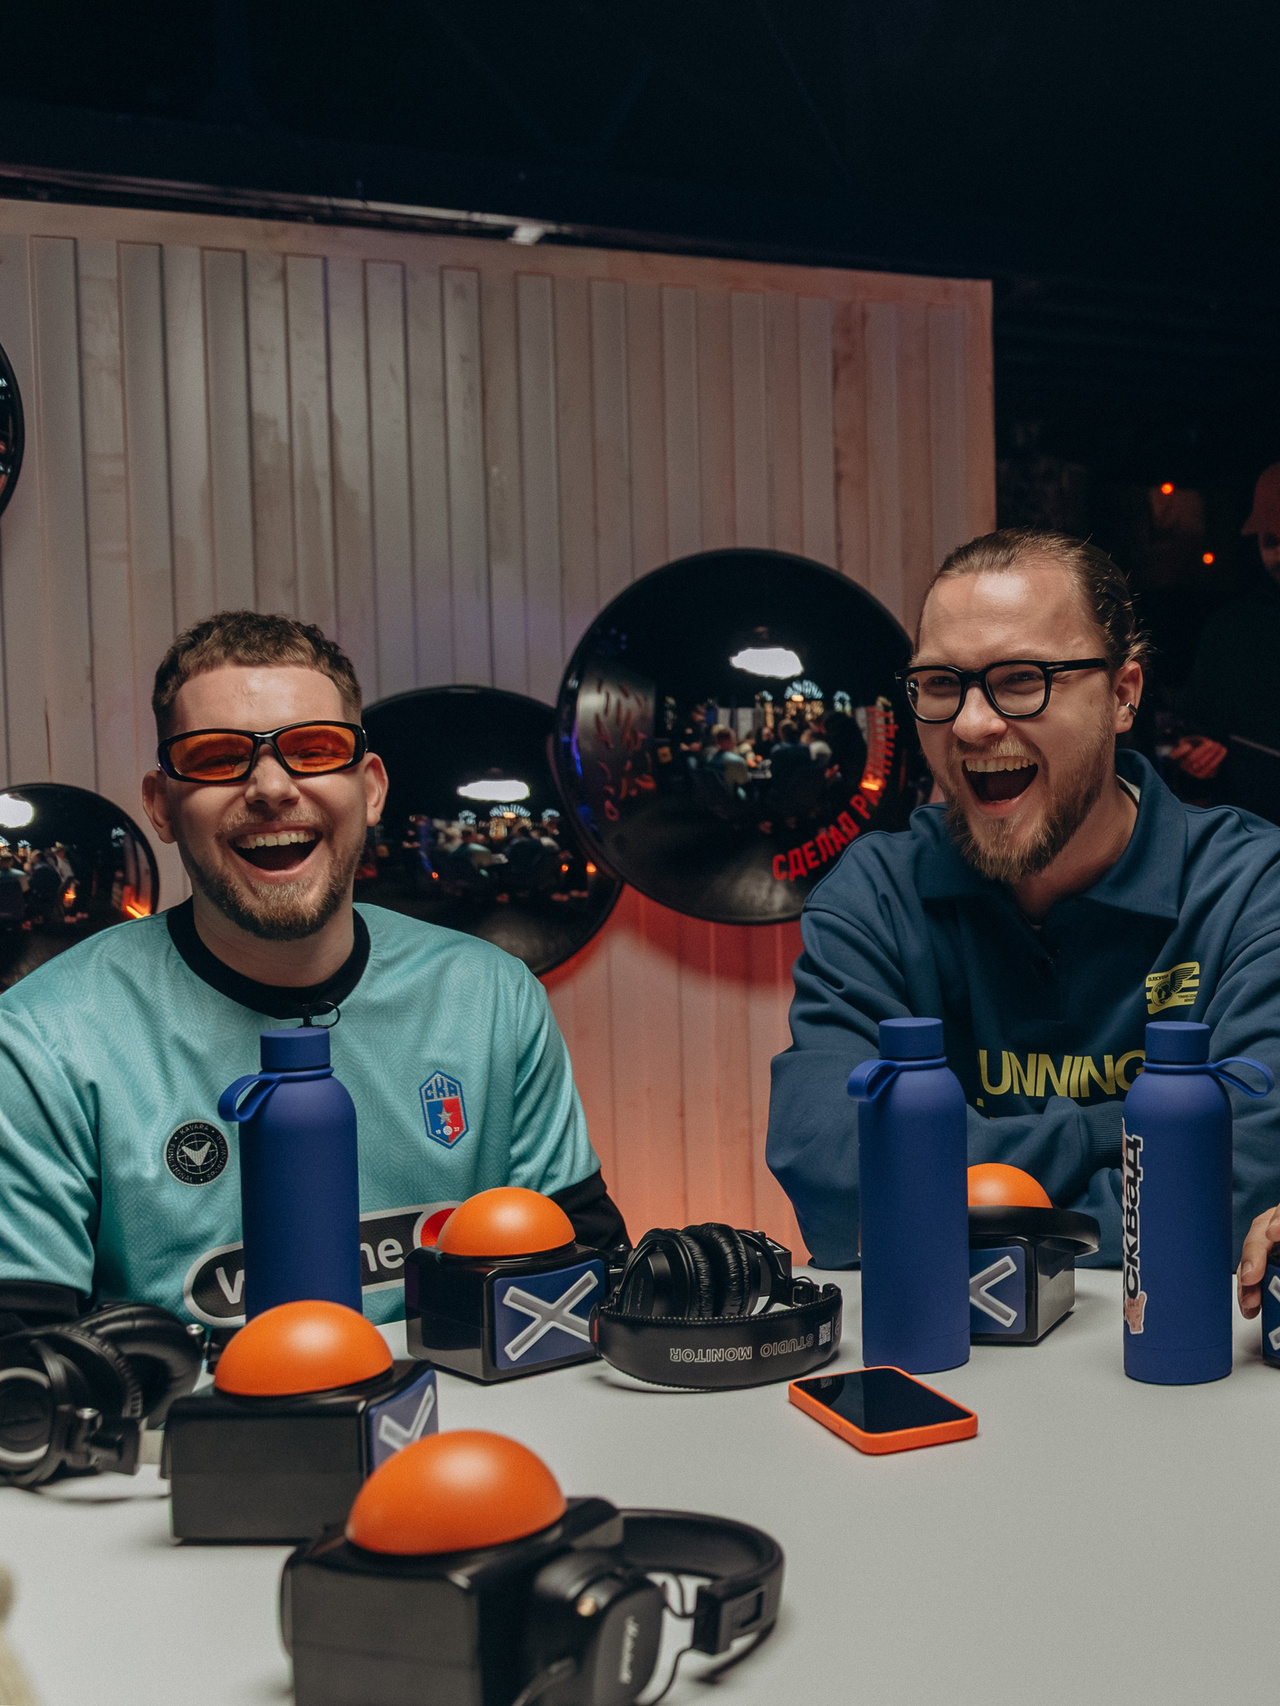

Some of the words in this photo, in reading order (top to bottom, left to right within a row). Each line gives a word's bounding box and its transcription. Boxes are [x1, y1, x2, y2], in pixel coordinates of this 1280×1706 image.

[424, 1077, 458, 1100] СКА
[180, 1123, 209, 1135] KAVARA
[669, 1346, 753, 1362] MONITOR
[760, 1333, 814, 1357] STUDIO
